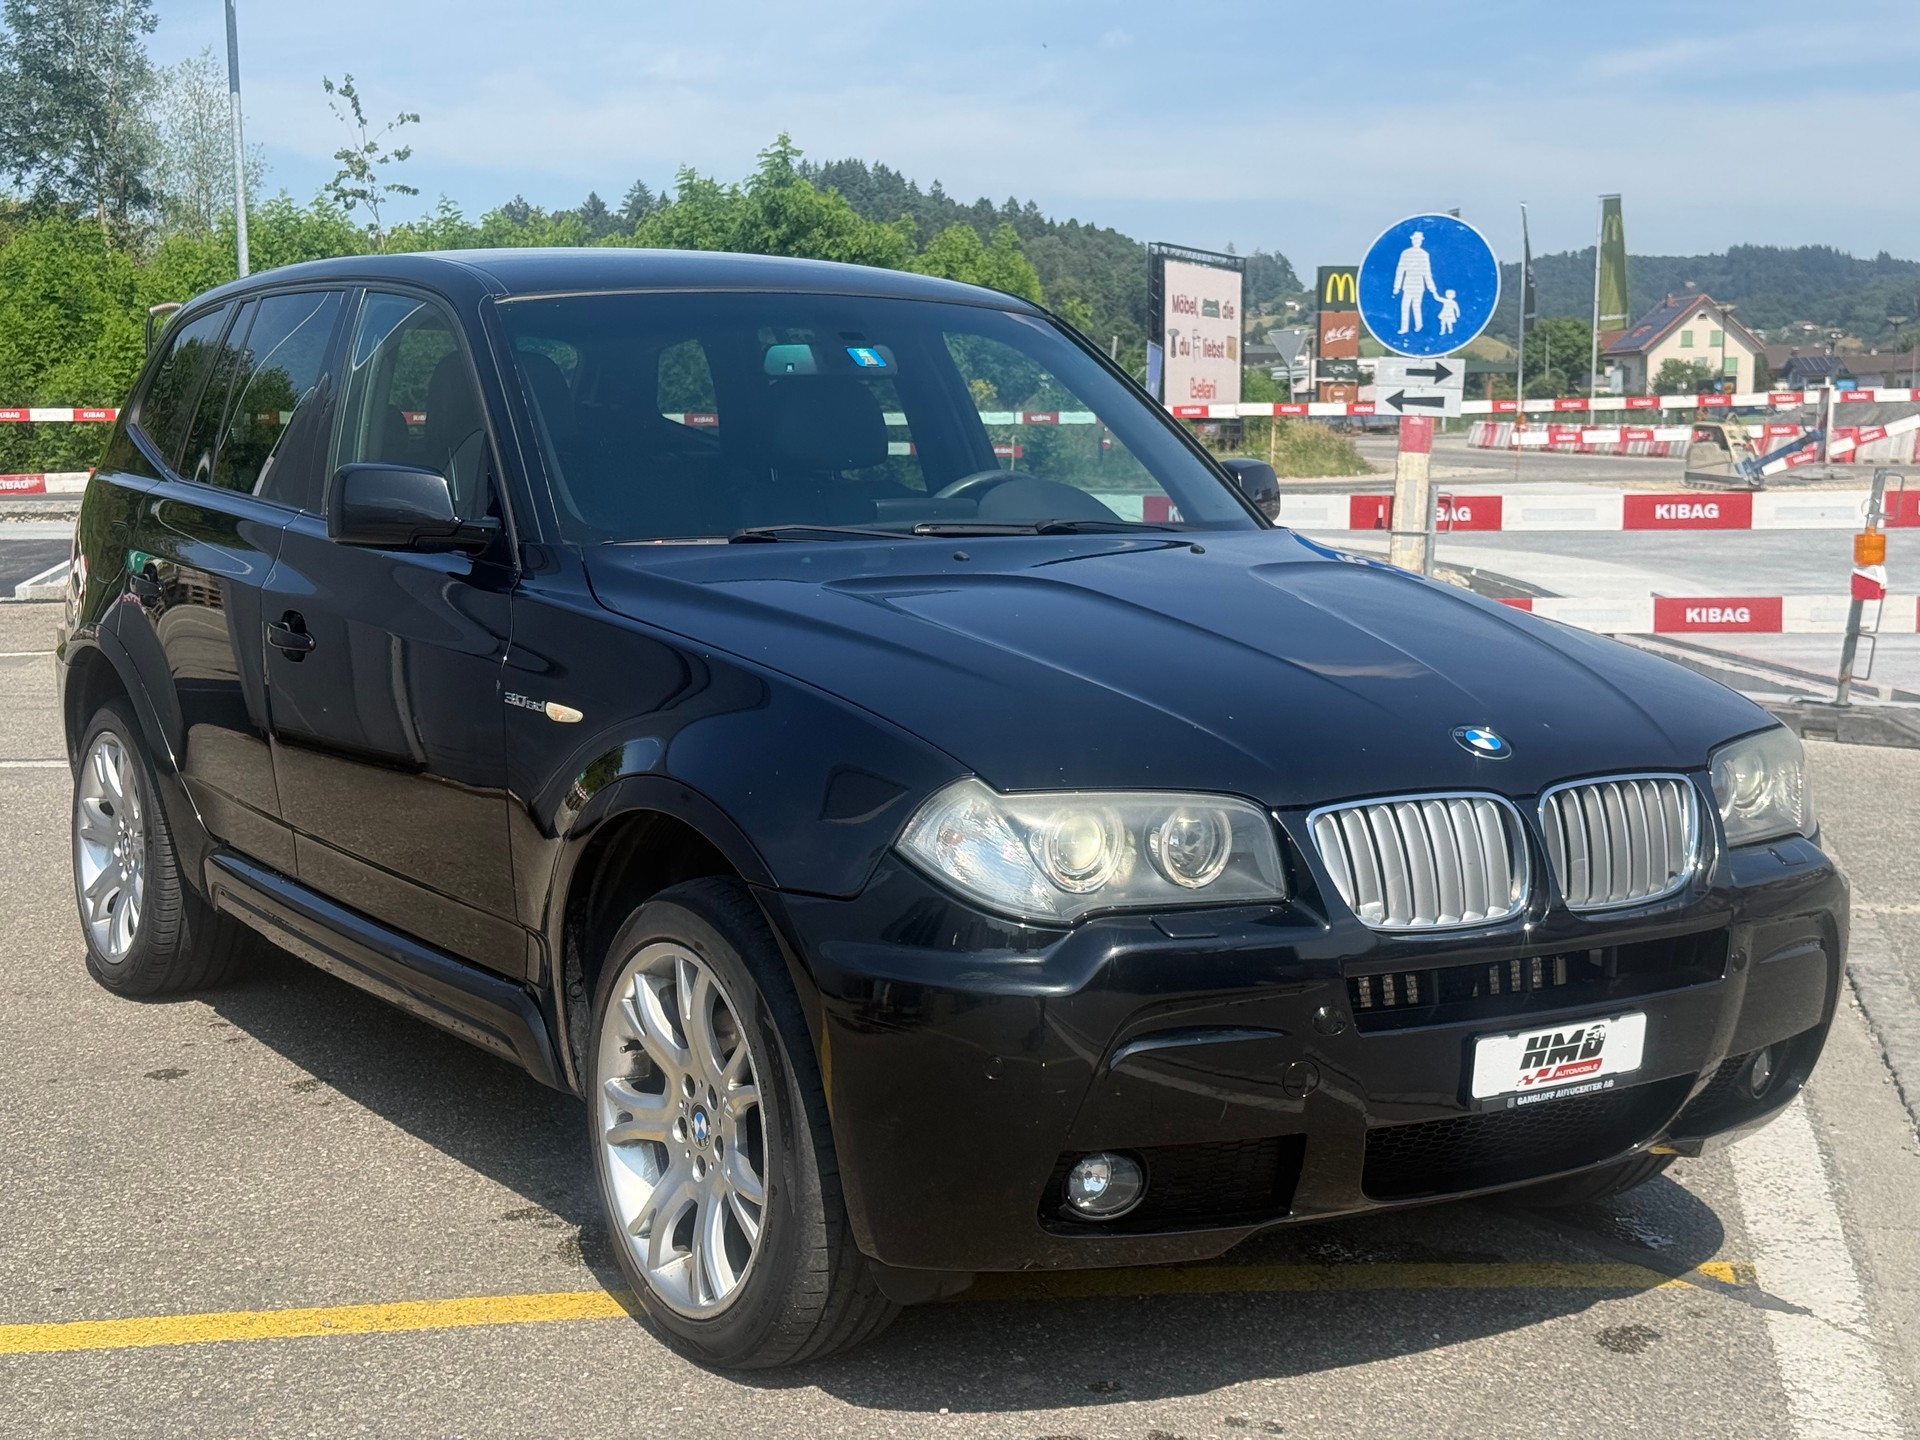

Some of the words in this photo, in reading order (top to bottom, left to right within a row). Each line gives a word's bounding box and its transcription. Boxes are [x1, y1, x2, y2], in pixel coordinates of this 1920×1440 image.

[1222, 301, 1235, 320] die
[1179, 337, 1190, 356] du
[1202, 338, 1225, 359] liebst
[1436, 505, 1472, 521] BAG
[1654, 503, 1720, 519] KIBAG
[1685, 607, 1751, 623] KIBAG
[1517, 1091, 1555, 1105] GANGLOFF
[1556, 1081, 1603, 1098] AUTOCENTER
[1603, 1079, 1615, 1088] AG
